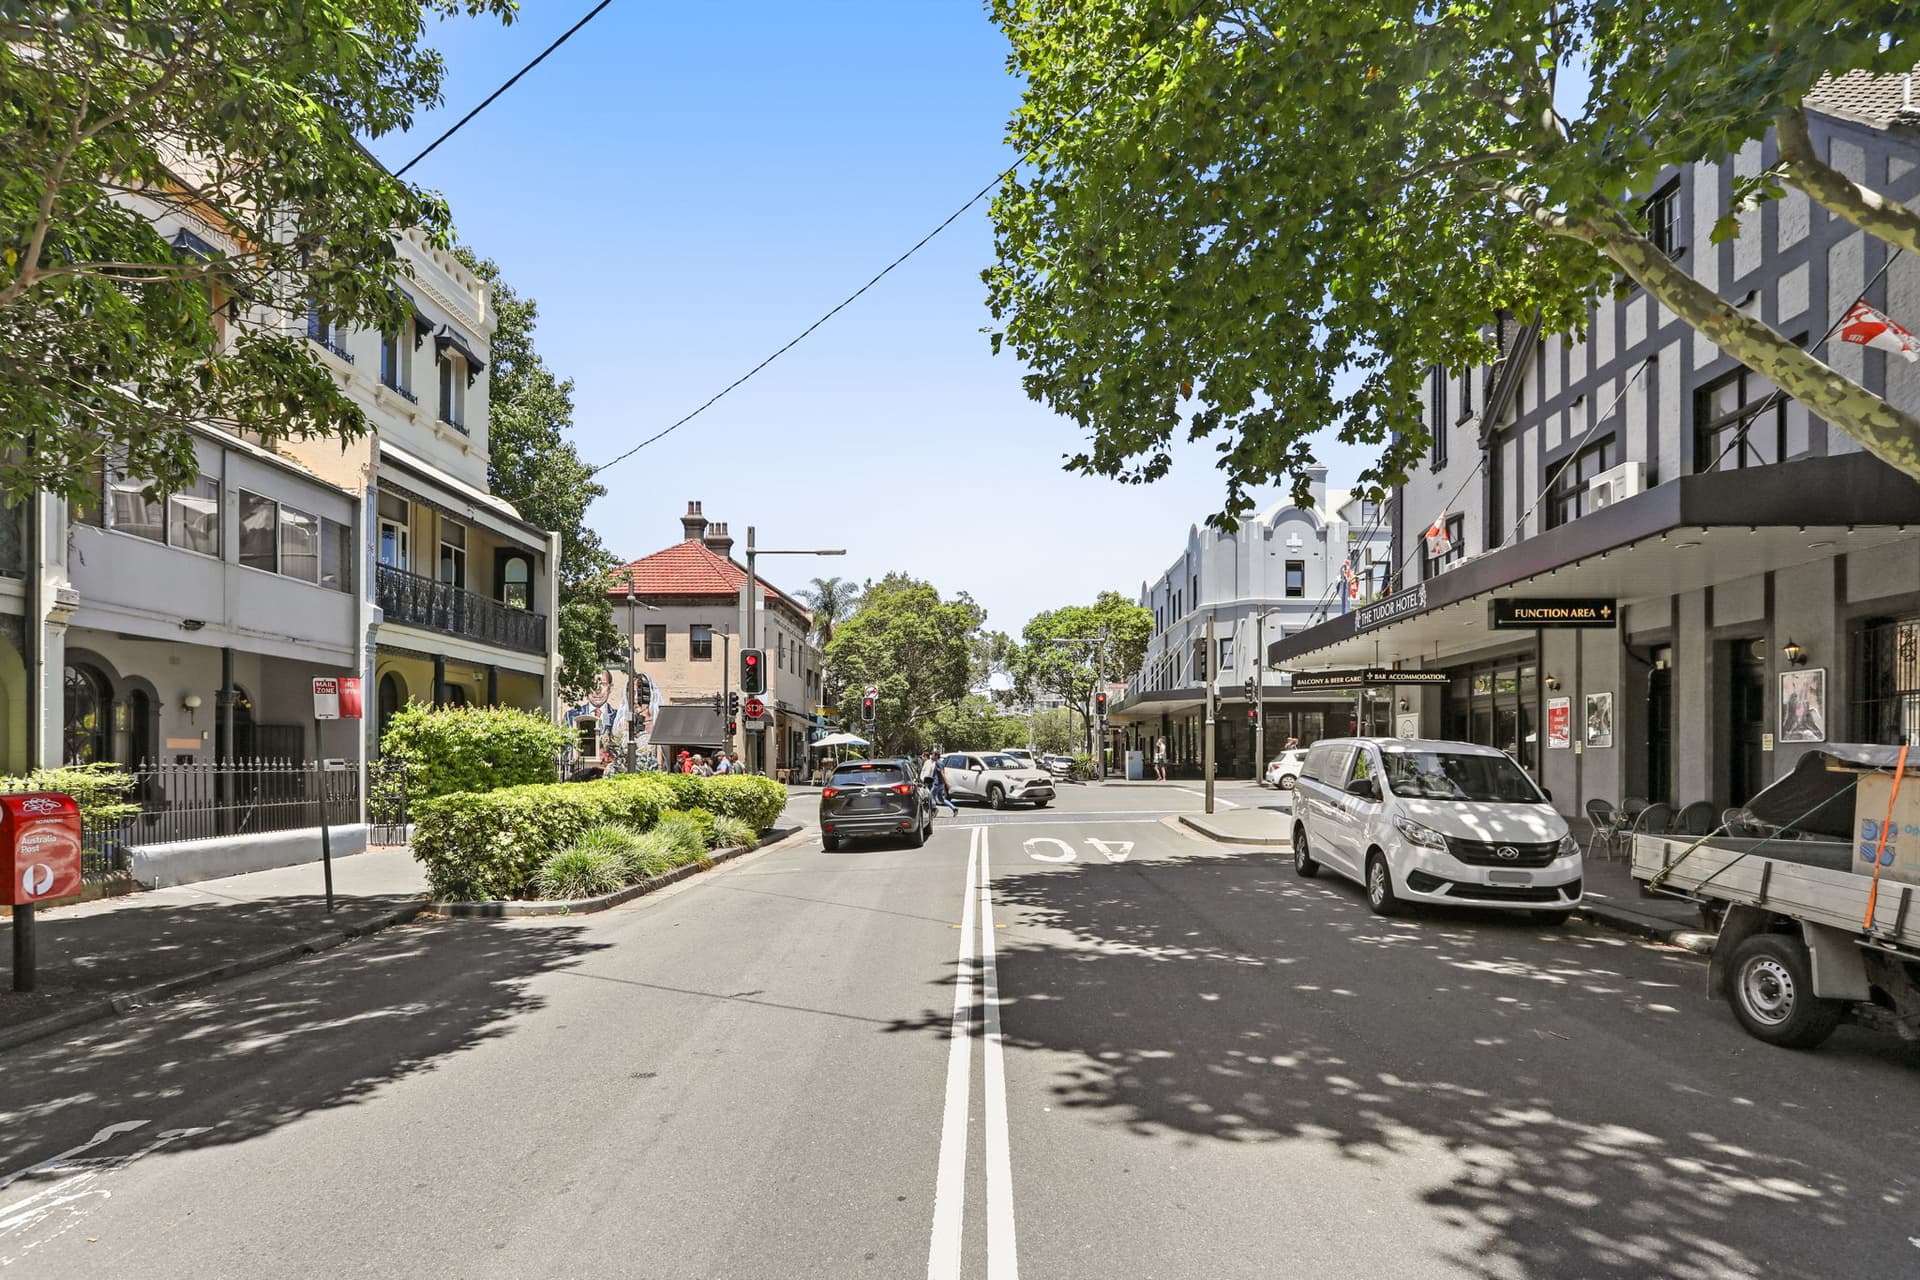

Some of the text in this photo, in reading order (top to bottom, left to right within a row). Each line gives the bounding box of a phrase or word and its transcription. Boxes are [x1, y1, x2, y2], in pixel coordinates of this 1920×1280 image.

[1361, 593, 1418, 625] THE TUDOR HOTEL
[1515, 608, 1596, 618] FUNCTION AREA
[1297, 678, 1323, 686] BALCONY
[747, 704, 763, 712] STOP
[21, 834, 57, 845] Australia
[21, 845, 40, 854] Post
